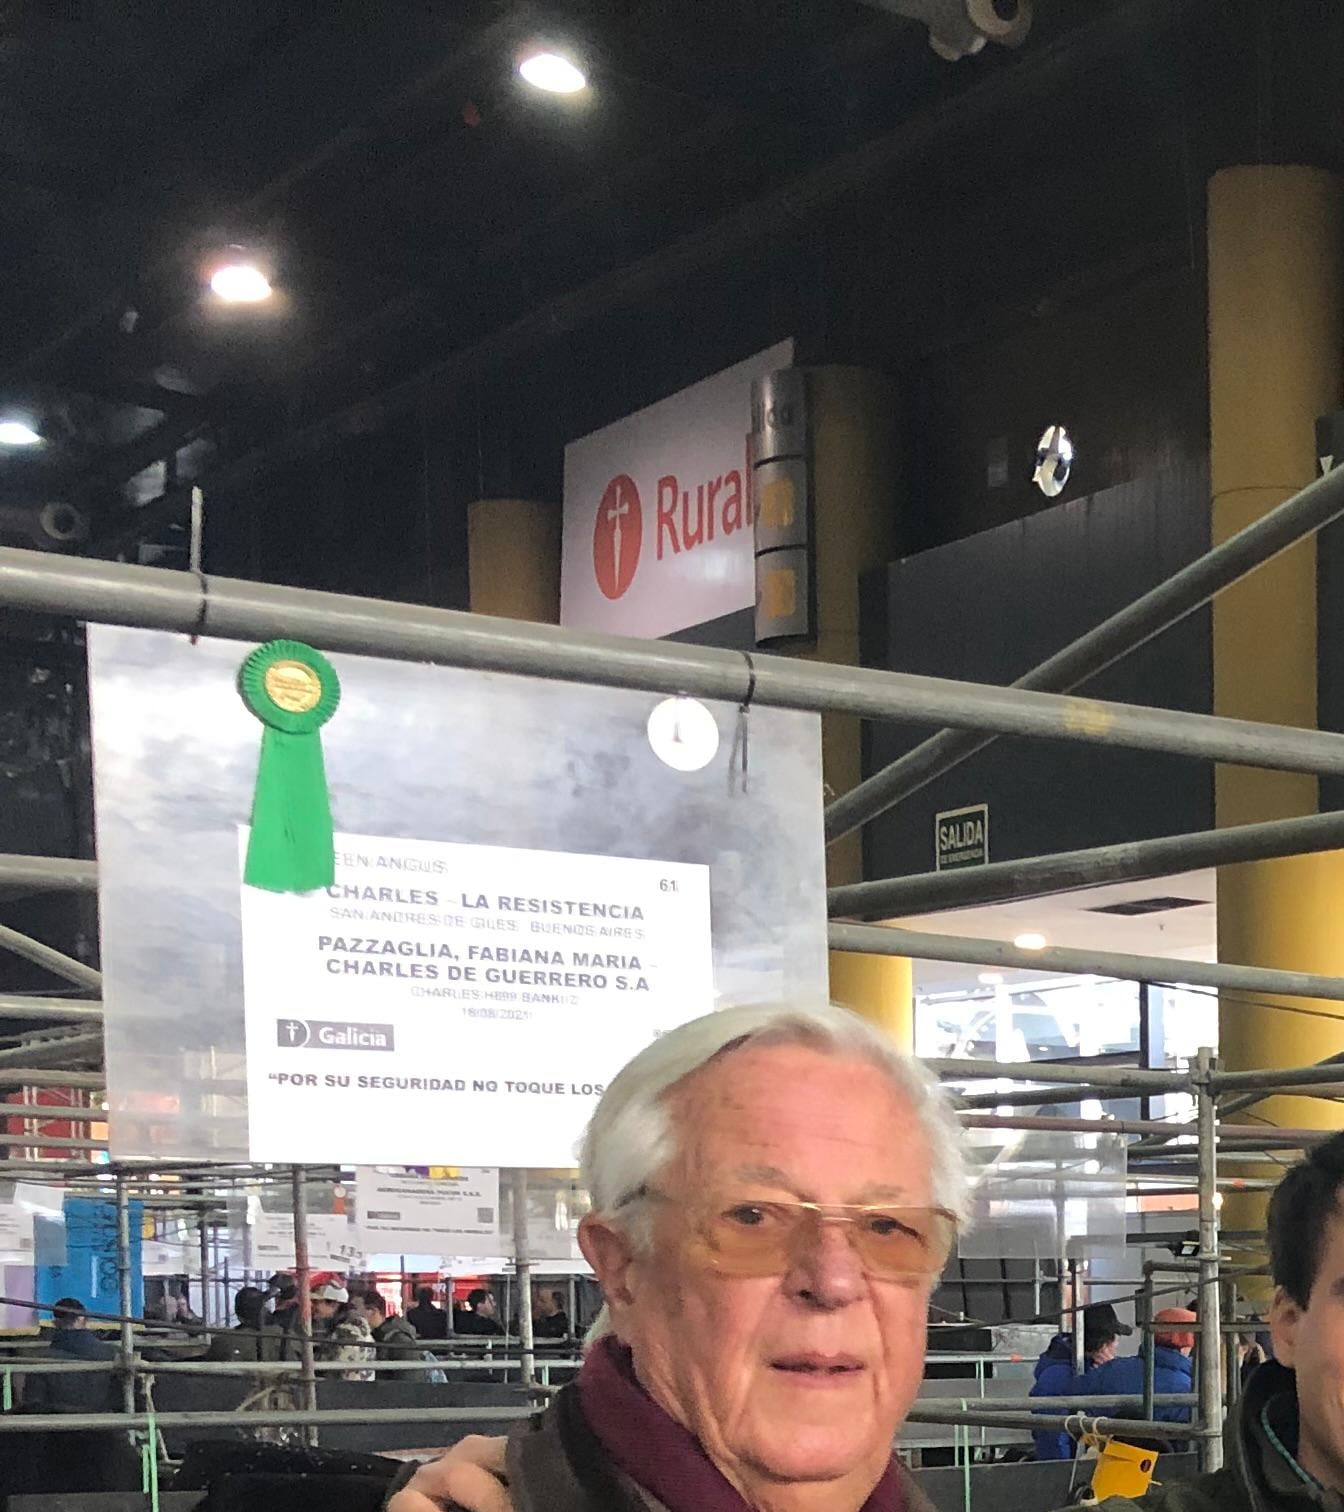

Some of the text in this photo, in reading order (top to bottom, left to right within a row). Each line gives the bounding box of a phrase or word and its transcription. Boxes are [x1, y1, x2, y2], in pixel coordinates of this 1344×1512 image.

[656, 432, 757, 560] Rural
[940, 820, 984, 851] SALIDA
[376, 856, 448, 874] ANGUS
[659, 878, 679, 893] 61
[326, 883, 438, 906] CHARLES
[461, 893, 490, 910] LA
[498, 896, 645, 921] RESISTENCIA
[329, 907, 646, 941] SAN ANDRES DE GILES BUENOS AIRES
[318, 935, 460, 962] PAZZAGLIA,
[468, 945, 565, 966] FABIANA
[572, 951, 642, 970] MARIA
[326, 958, 650, 991] CHARLES DE GUERRERO S.A
[318, 1026, 387, 1047] Galicia
[324, 1074, 351, 1088] SU
[357, 1075, 466, 1092] SEGURIDAD
[472, 1079, 498, 1093] NO
[504, 1080, 565, 1095] TOQUE
[571, 1083, 605, 1097] LOS
